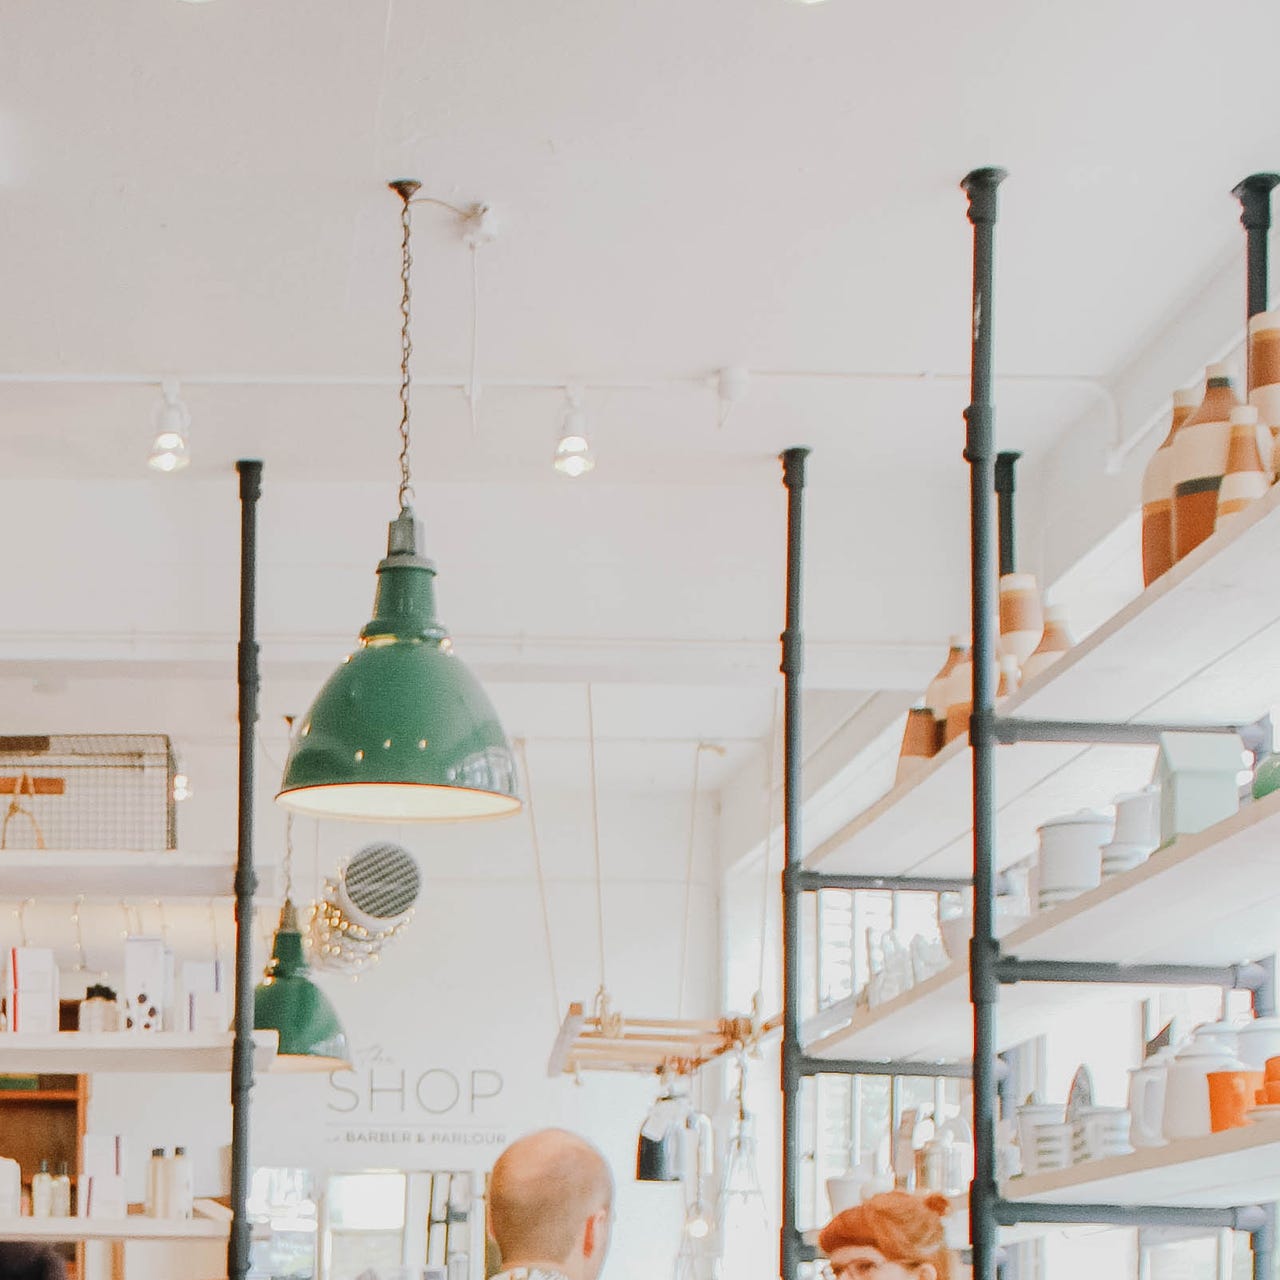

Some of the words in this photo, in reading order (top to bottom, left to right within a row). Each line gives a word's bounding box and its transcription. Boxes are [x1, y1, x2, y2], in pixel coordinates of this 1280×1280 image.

[327, 1068, 504, 1114] SHOP
[346, 1131, 411, 1144] BARBER
[431, 1131, 507, 1144] PARLOUR
